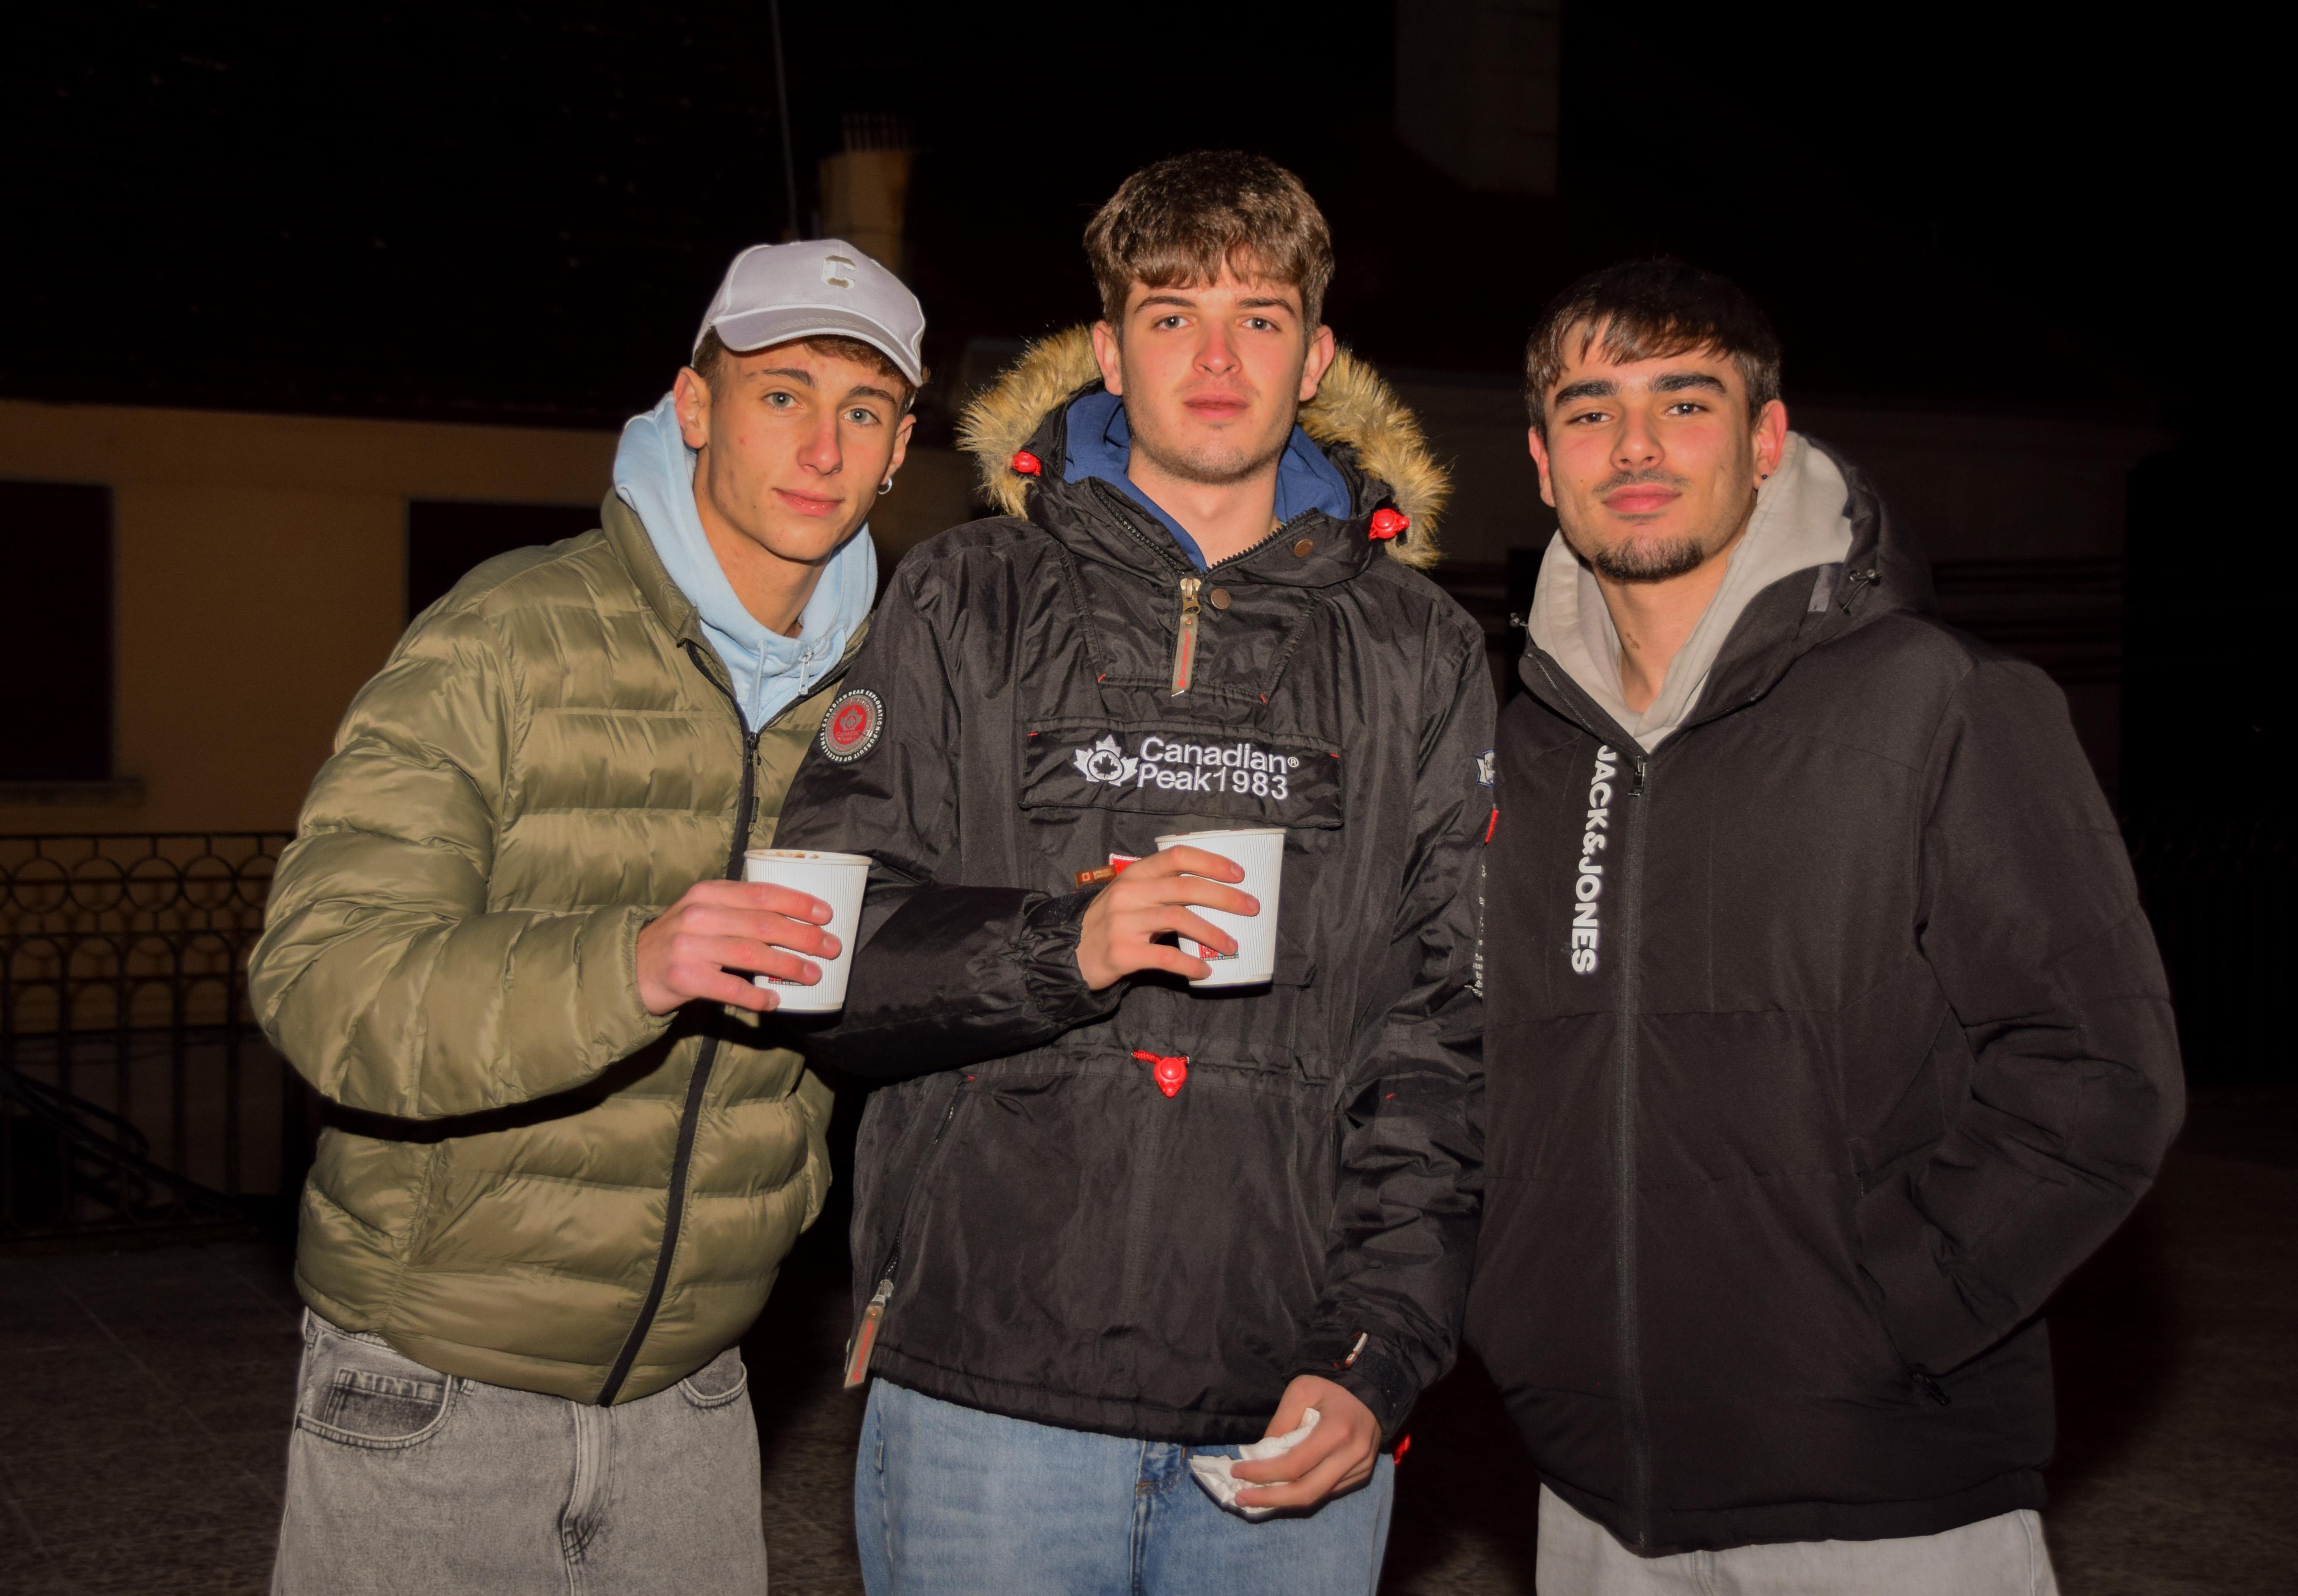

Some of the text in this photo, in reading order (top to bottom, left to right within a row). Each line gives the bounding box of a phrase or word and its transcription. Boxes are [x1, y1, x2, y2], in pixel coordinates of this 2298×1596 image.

[822, 694, 847, 727] CANADIAN
[865, 690, 883, 731] EXPLORATION
[820, 732, 843, 762] EXCELLENCE
[854, 734, 878, 759] PURSUIT
